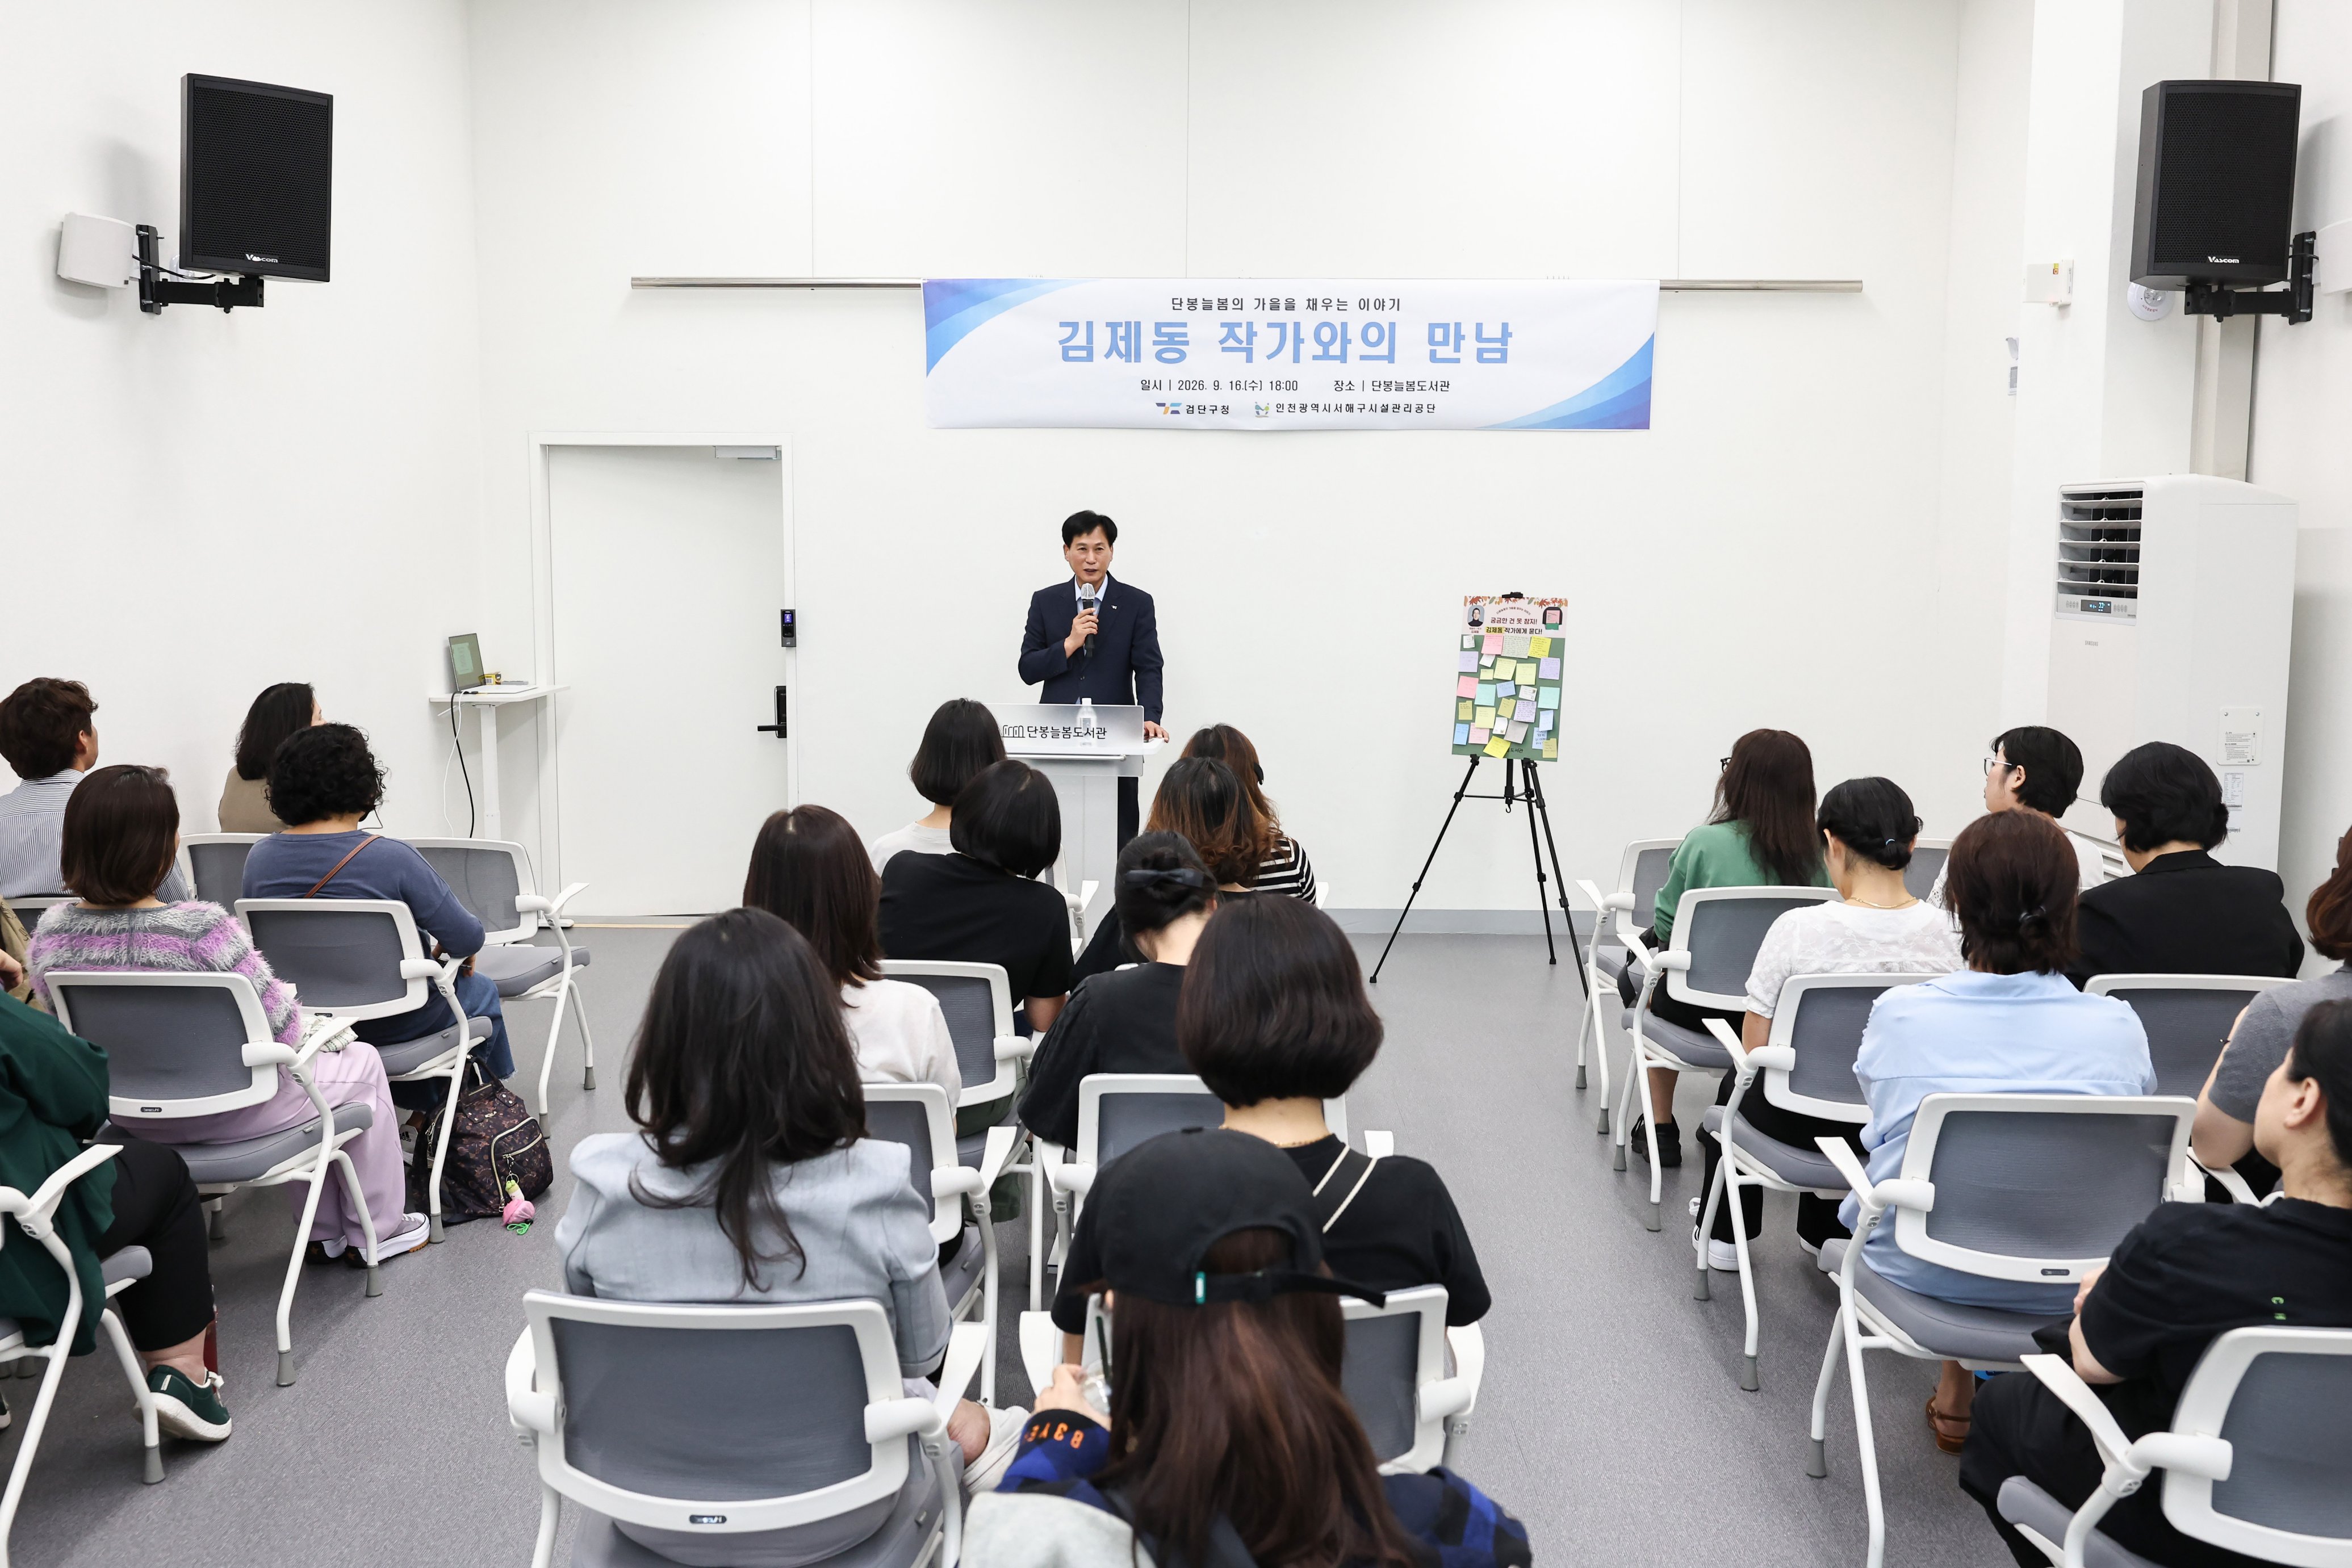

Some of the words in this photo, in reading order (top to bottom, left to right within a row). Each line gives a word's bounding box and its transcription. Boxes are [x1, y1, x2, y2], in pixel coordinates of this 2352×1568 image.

[1171, 297, 1243, 311] 단봉늘봄의
[1254, 297, 1296, 311] 가을을
[1305, 298, 1348, 311] 채우는
[1358, 298, 1400, 311] 이야기
[1058, 320, 1190, 364] 김제동
[1219, 321, 1396, 364] 작가와의
[1428, 321, 1513, 364] 만남
[1141, 379, 1162, 391] 일시
[1178, 380, 1207, 391] 2026.
[1213, 380, 1222, 391] 9.
[1269, 380, 1298, 391] 18:00
[1334, 380, 1355, 392] 장소
[1372, 380, 1450, 392] 단봉늘봄도서관
[1186, 404, 1230, 415] 검단구청
[1275, 403, 1436, 414] 인천광역시서해구시설관리공단
[1027, 726, 1107, 740] 단봉늘봄도서관
